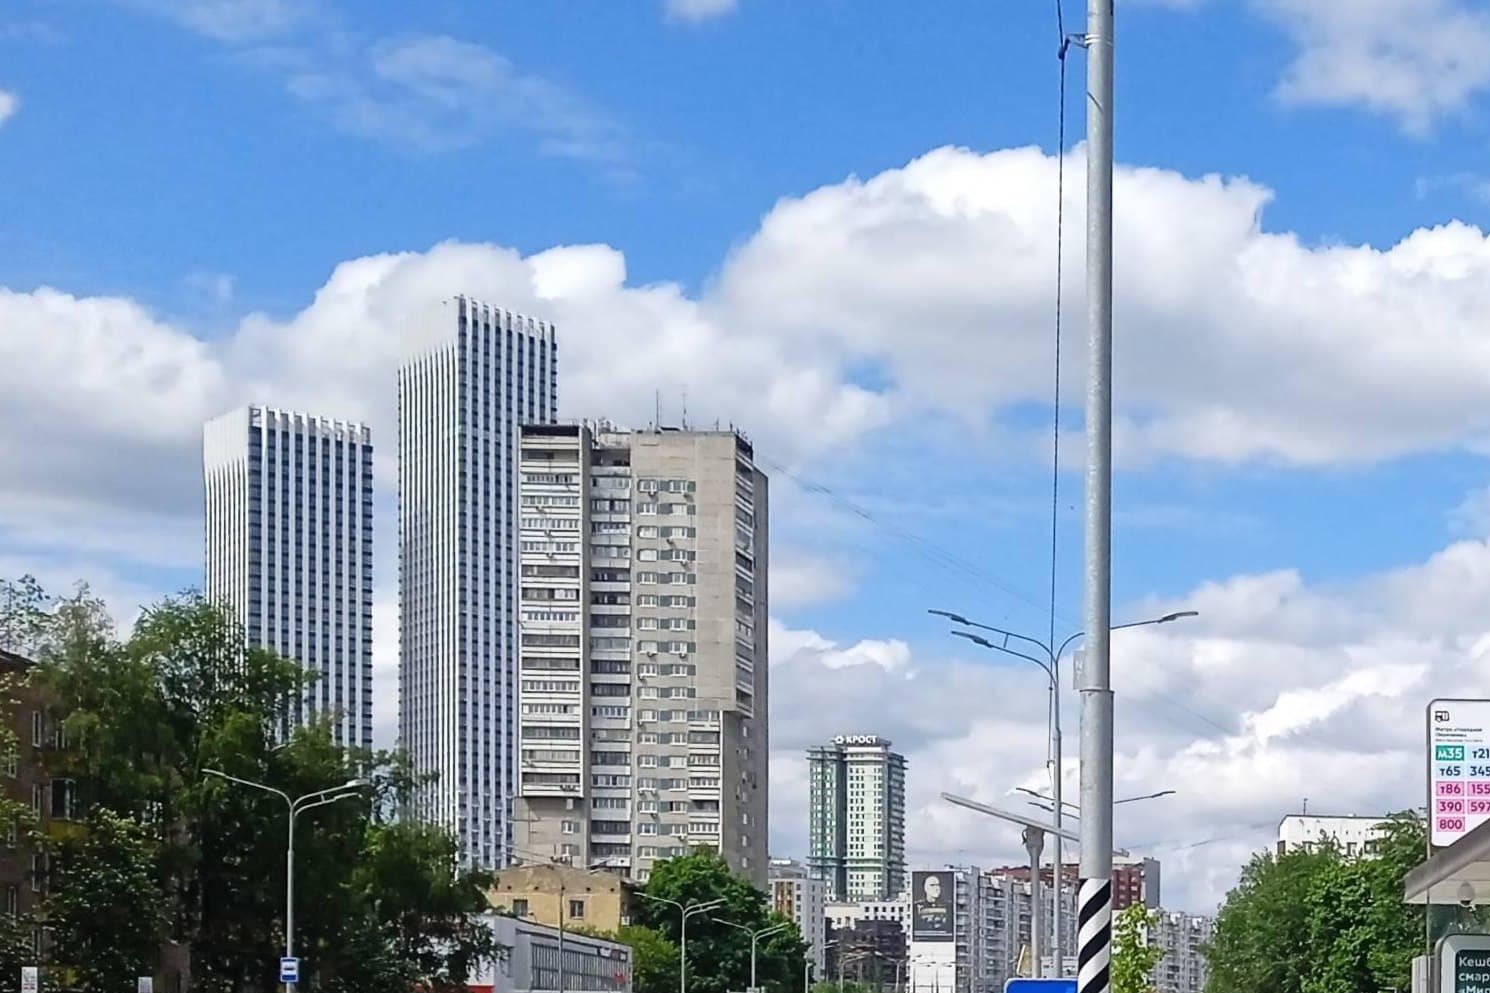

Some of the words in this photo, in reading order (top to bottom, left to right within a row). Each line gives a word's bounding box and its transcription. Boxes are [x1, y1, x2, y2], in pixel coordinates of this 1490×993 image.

[1472, 784, 1490, 795] 155
[1440, 801, 1462, 812] 390
[1439, 819, 1463, 830] 800
